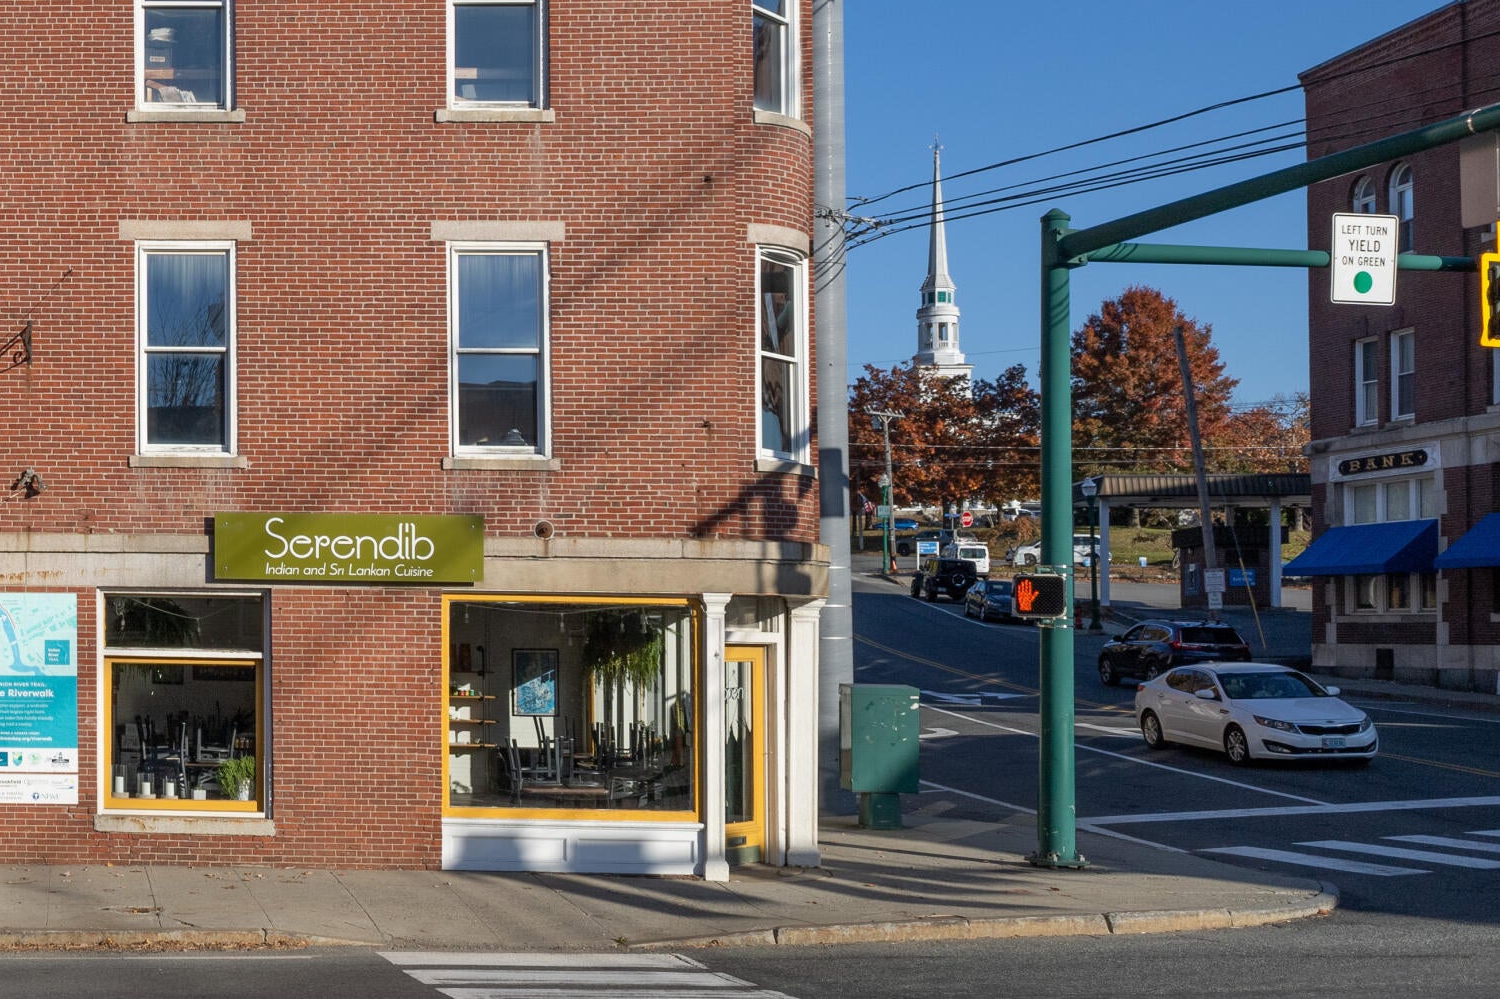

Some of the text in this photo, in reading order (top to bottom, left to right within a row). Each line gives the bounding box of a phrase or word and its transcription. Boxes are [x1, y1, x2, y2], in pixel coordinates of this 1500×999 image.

[1341, 225, 1388, 236] LEFT TURN
[1348, 240, 1381, 253] YIELD
[1341, 256, 1386, 267] ON GREEN
[1349, 453, 1414, 472] BANK
[264, 517, 435, 561] Serendib
[265, 562, 433, 577] Indian and Sri Lankan Cuisine
[8, 689, 54, 697] Riverwalk
